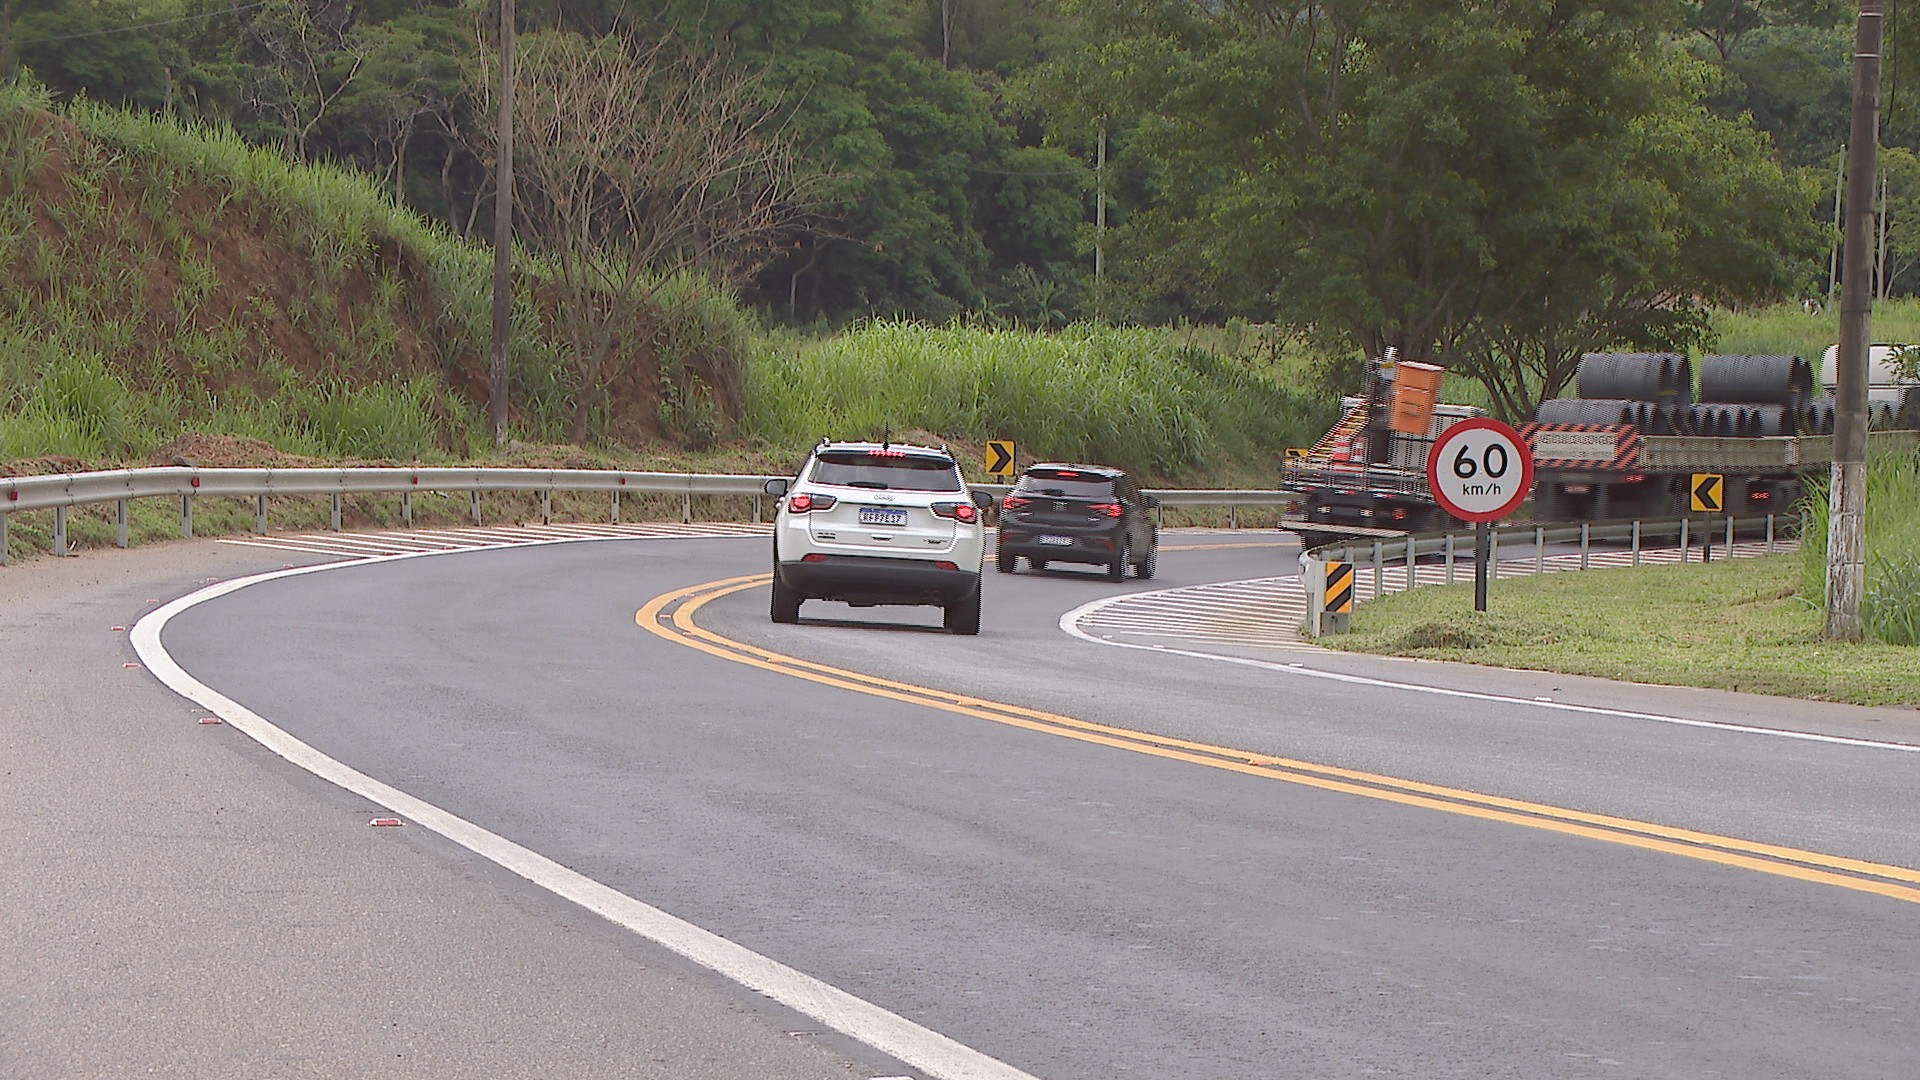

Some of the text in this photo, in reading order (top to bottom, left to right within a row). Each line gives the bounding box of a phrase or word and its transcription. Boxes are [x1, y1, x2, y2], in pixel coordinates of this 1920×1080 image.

[1580, 435, 1615, 446] LONGO
[1453, 443, 1508, 479] 60
[1462, 483, 1501, 496] km/h
